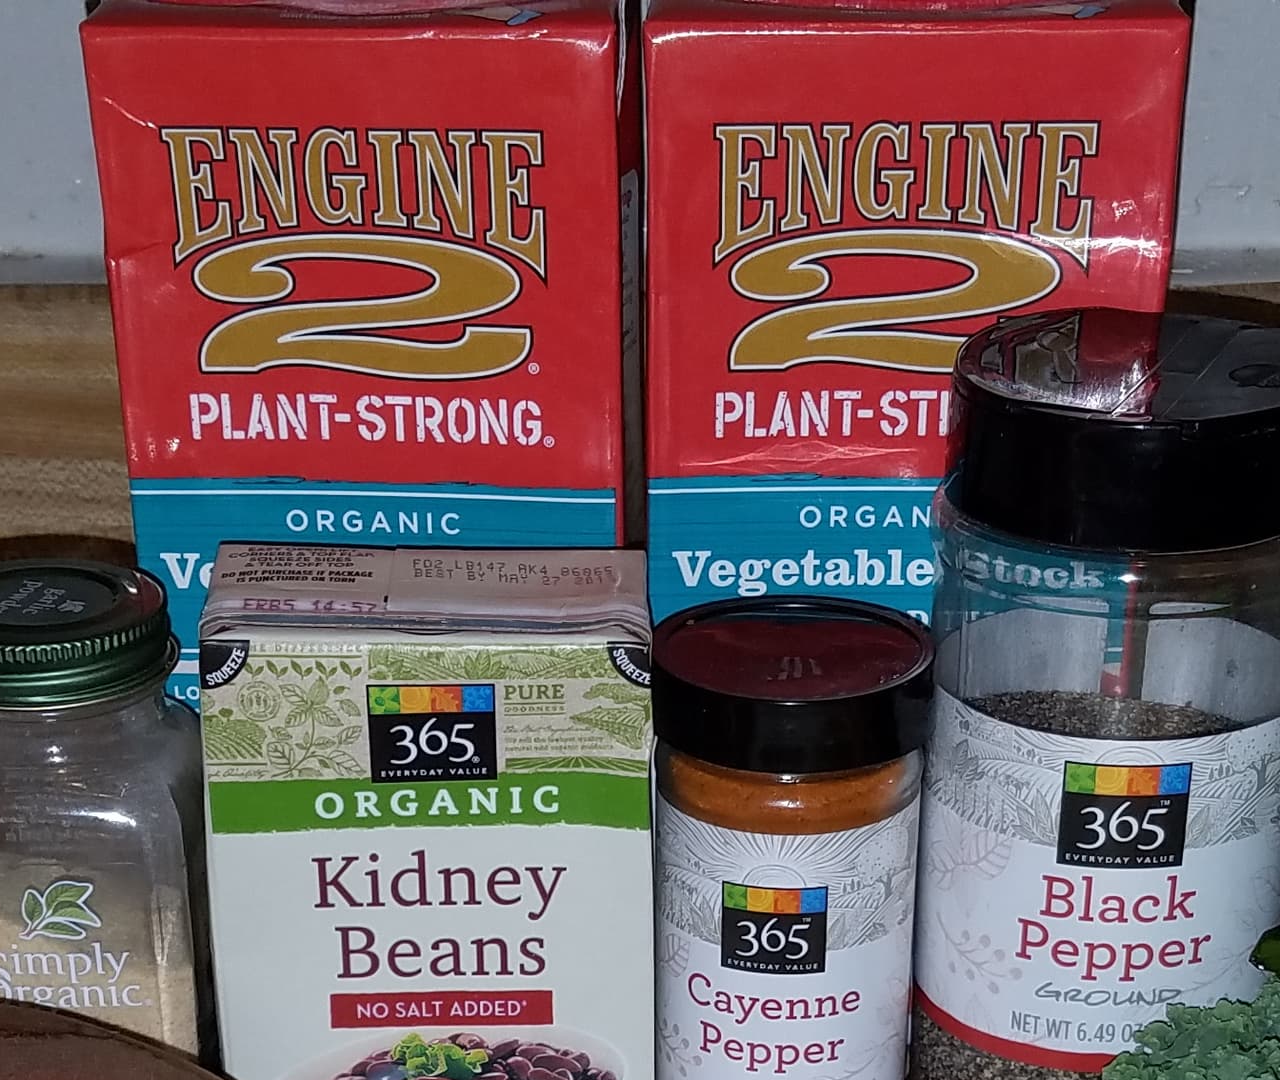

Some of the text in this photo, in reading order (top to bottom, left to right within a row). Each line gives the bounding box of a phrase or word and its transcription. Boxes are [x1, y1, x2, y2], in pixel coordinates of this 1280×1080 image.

[160, 127, 547, 286] ENGINE
[713, 120, 1099, 276] ENGINE
[193, 233, 532, 380] 2
[728, 228, 1063, 373] 2
[189, 393, 545, 446] PLANT-STRONG
[286, 510, 461, 536] ORGANIC
[328, 570, 374, 578] PACKAGE
[414, 568, 454, 578] BEST
[467, 571, 486, 582] BY
[498, 573, 528, 584] MAY
[542, 576, 561, 586] 27
[672, 549, 1106, 595] Vegetable Stock
[205, 646, 246, 686] SQUEEZE
[612, 648, 650, 685] SQUEEZE
[504, 684, 565, 700] PURE
[390, 717, 475, 764] 365
[380, 768, 488, 778] EVERYDAY VALUE
[314, 785, 561, 820] ORGANIC
[1075, 801, 1169, 851] 365
[1064, 853, 1176, 866] EVERYDAY VALUE
[311, 848, 568, 921] Kidney
[1039, 874, 1198, 924] Black
[335, 926, 547, 980] Beans
[735, 916, 811, 960] 365
[1015, 917, 1212, 982] Pepper
[727, 958, 819, 971] EVERYDAY VALUE
[357, 1003, 390, 1019] NO
[394, 1002, 444, 1019] SALT
[687, 972, 861, 1025] Cayenne
[1034, 982, 1182, 1006] GROUND
[699, 1020, 845, 1074] Pepper
[1010, 1010, 1040, 1035] NET
[1046, 1018, 1072, 1040] WT
[1077, 1022, 1116, 1042] 6.49
